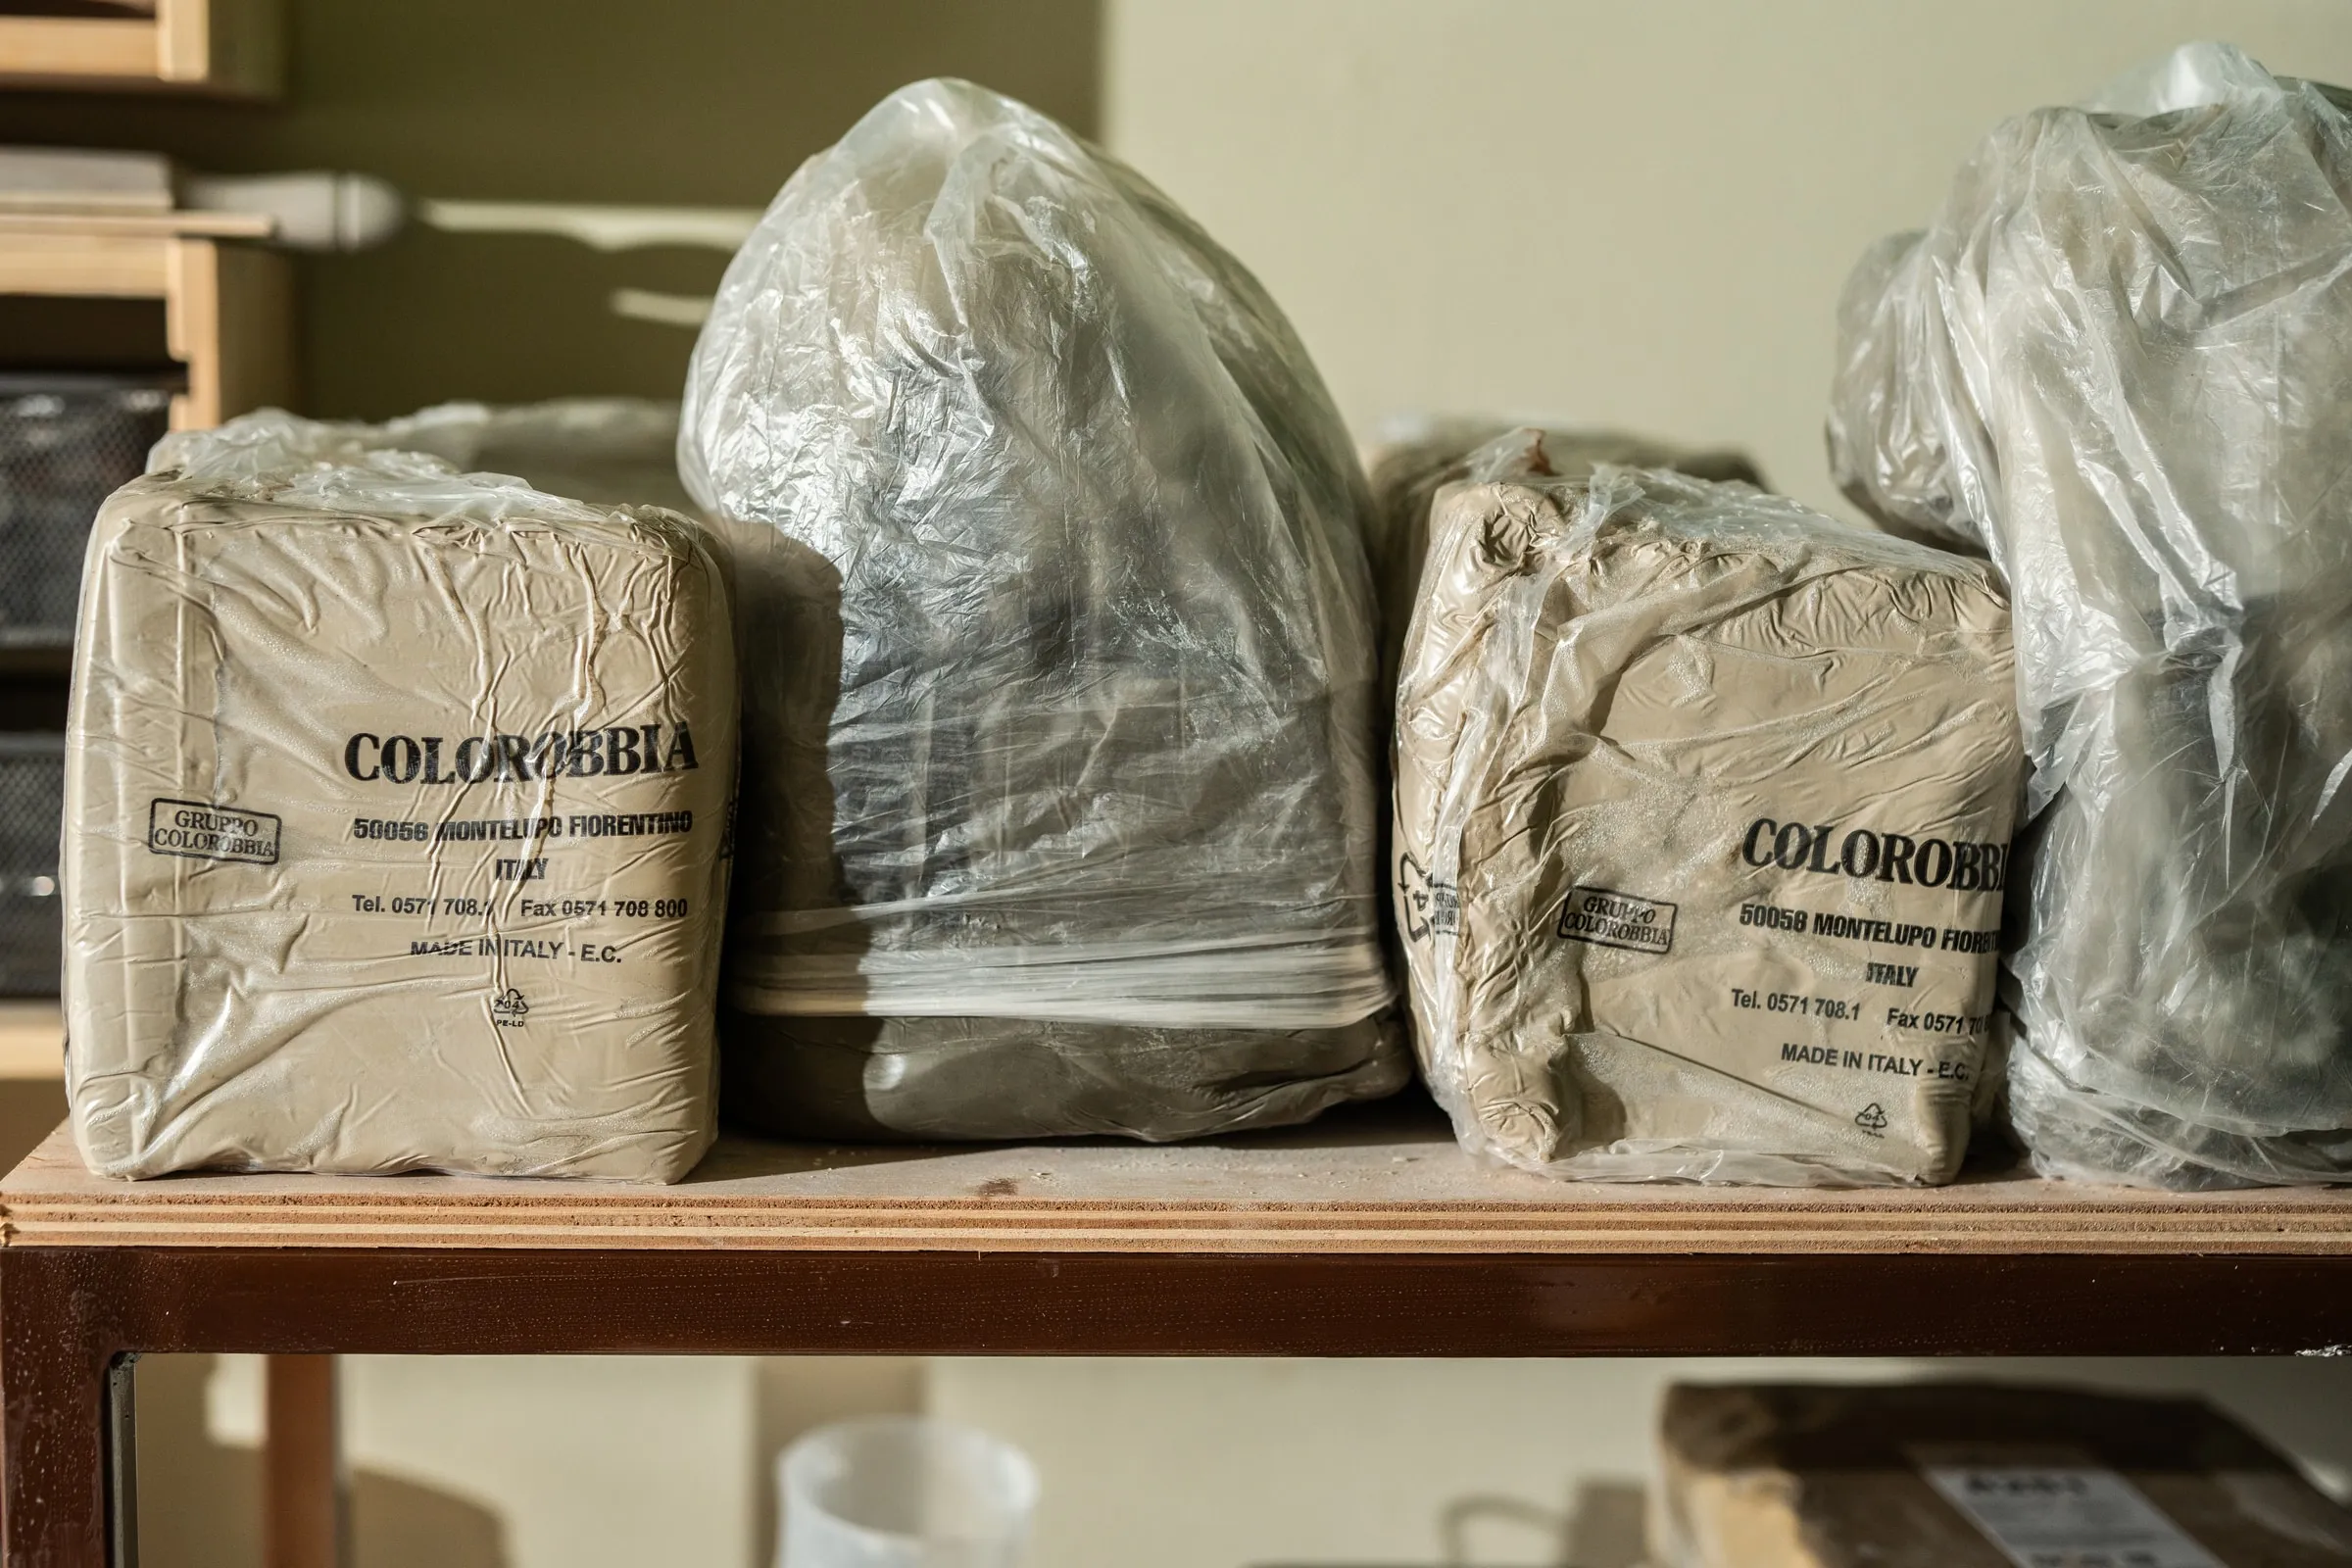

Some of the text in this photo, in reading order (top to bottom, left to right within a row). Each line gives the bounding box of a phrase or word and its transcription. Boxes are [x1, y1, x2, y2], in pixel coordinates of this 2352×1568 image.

[345, 720, 699, 785] COLOROBBIA
[174, 809, 259, 836] GRUPPO
[435, 815, 563, 842] MONTELUPO
[568, 810, 693, 838] FIORENTINO
[154, 828, 274, 858] COLOROBBIA
[1741, 817, 2009, 892] COLOROBBI
[496, 858, 549, 880] ITALY
[352, 894, 386, 913] Tel.
[391, 897, 437, 915] 0571
[520, 899, 557, 917] Fax
[562, 900, 608, 917] 0571
[613, 901, 649, 918] 708
[654, 898, 688, 918] 800
[1583, 896, 1656, 924] GRUPPO
[1564, 911, 1670, 946] COLOROBBIA
[1813, 912, 1936, 949] MONTELUPO
[411, 939, 473, 956] MADE
[478, 938, 498, 956] IN
[504, 939, 564, 959] ITALY
[580, 943, 622, 963] E.C.
[1864, 961, 1920, 988] ITALY
[504, 1000, 520, 1009] 04
[1731, 988, 1762, 1010] Tel.
[1766, 992, 1810, 1015] 0571
[1815, 998, 1861, 1022] 708.1
[1886, 1007, 1919, 1030] Fax
[1923, 1012, 1965, 1036] 0571
[496, 1019, 525, 1028] PE-LD
[1781, 1043, 1838, 1067] MADE
[1842, 1051, 1863, 1070] IN
[1867, 1054, 1925, 1078] ITALY
